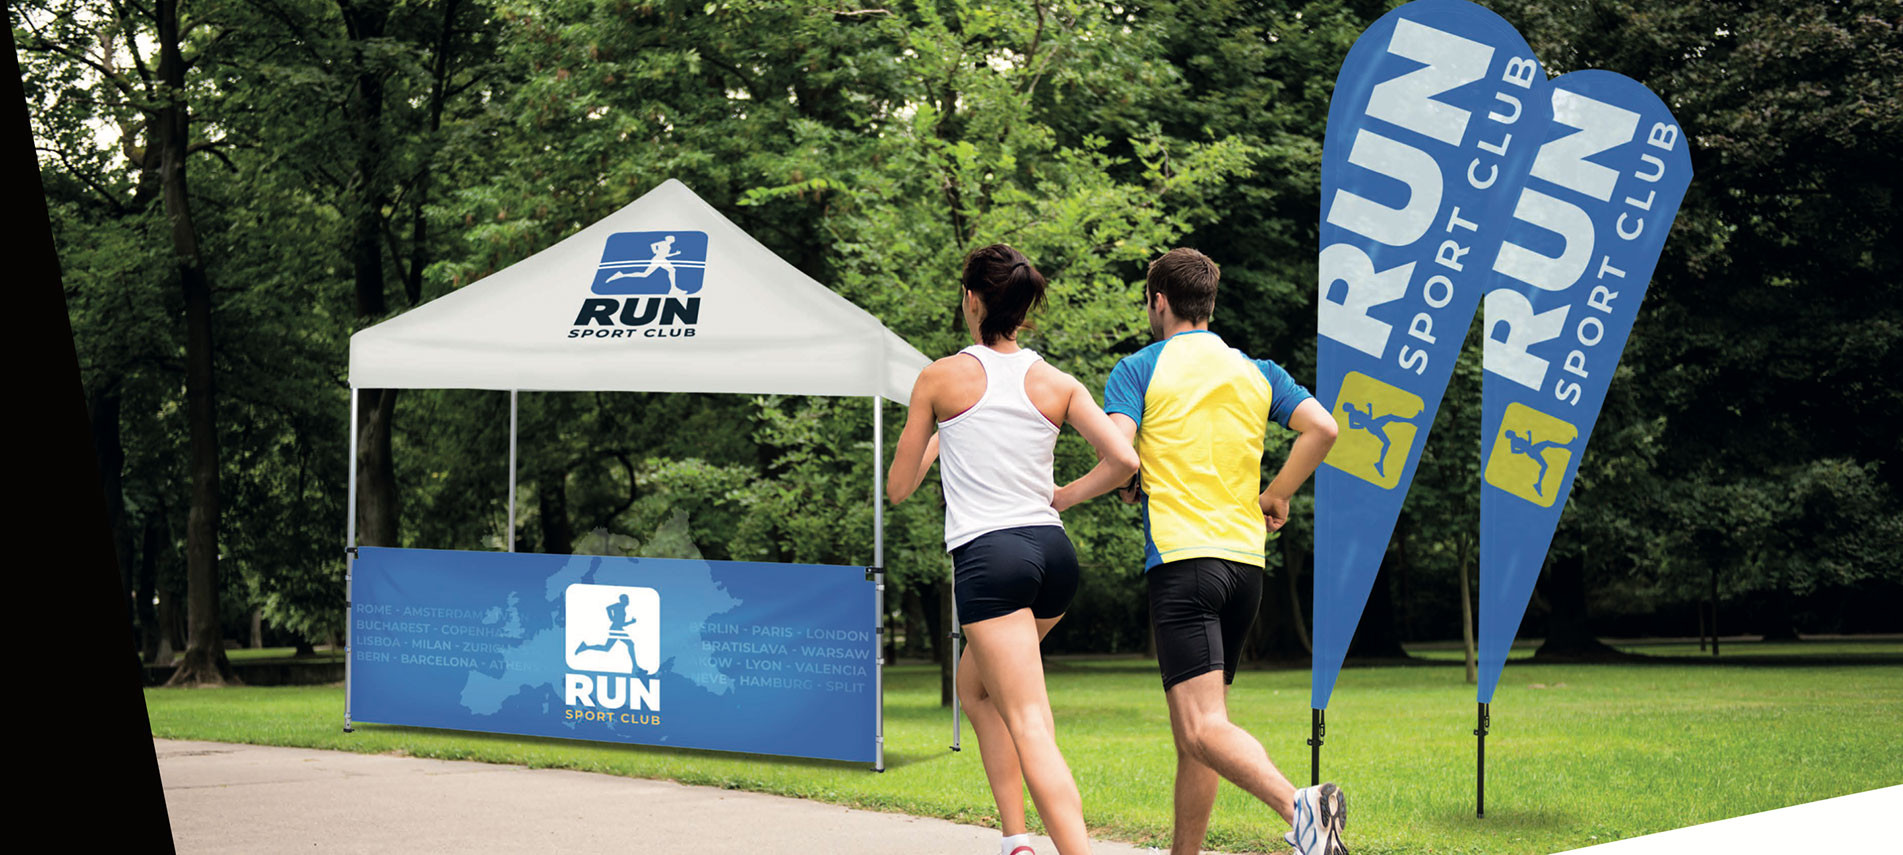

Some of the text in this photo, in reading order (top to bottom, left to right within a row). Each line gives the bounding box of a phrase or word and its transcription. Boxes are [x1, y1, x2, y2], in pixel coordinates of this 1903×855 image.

[1317, 17, 1496, 360] RUN
[1397, 56, 1537, 376] SPORT CLUB
[1482, 87, 1641, 392] RUN
[1554, 121, 1678, 406] SPORT CLUB
[573, 297, 701, 326] RUN
[567, 328, 696, 338] SPORT CLUB
[356, 603, 393, 615] ROME
[403, 606, 483, 620] AMSTERDAM
[356, 619, 431, 634] BUCHAREST
[441, 624, 506, 638] COPENHA
[689, 622, 739, 634] BERLIN
[752, 625, 793, 638] PARIS
[806, 628, 869, 642] LONDON
[356, 635, 400, 647] LISBOA
[412, 638, 452, 650] MILAN
[702, 640, 788, 655] BRATISLAVA
[801, 646, 870, 660] WARSAW
[357, 651, 389, 663] BERN
[400, 654, 479, 669] BARCELONA
[745, 659, 782, 671] LYON
[794, 662, 867, 677] VALENCIA
[565, 673, 661, 712] RUN
[740, 675, 813, 690] HAMBURG
[825, 681, 865, 694] SPLIT
[565, 709, 661, 726] SPORT CLUB
